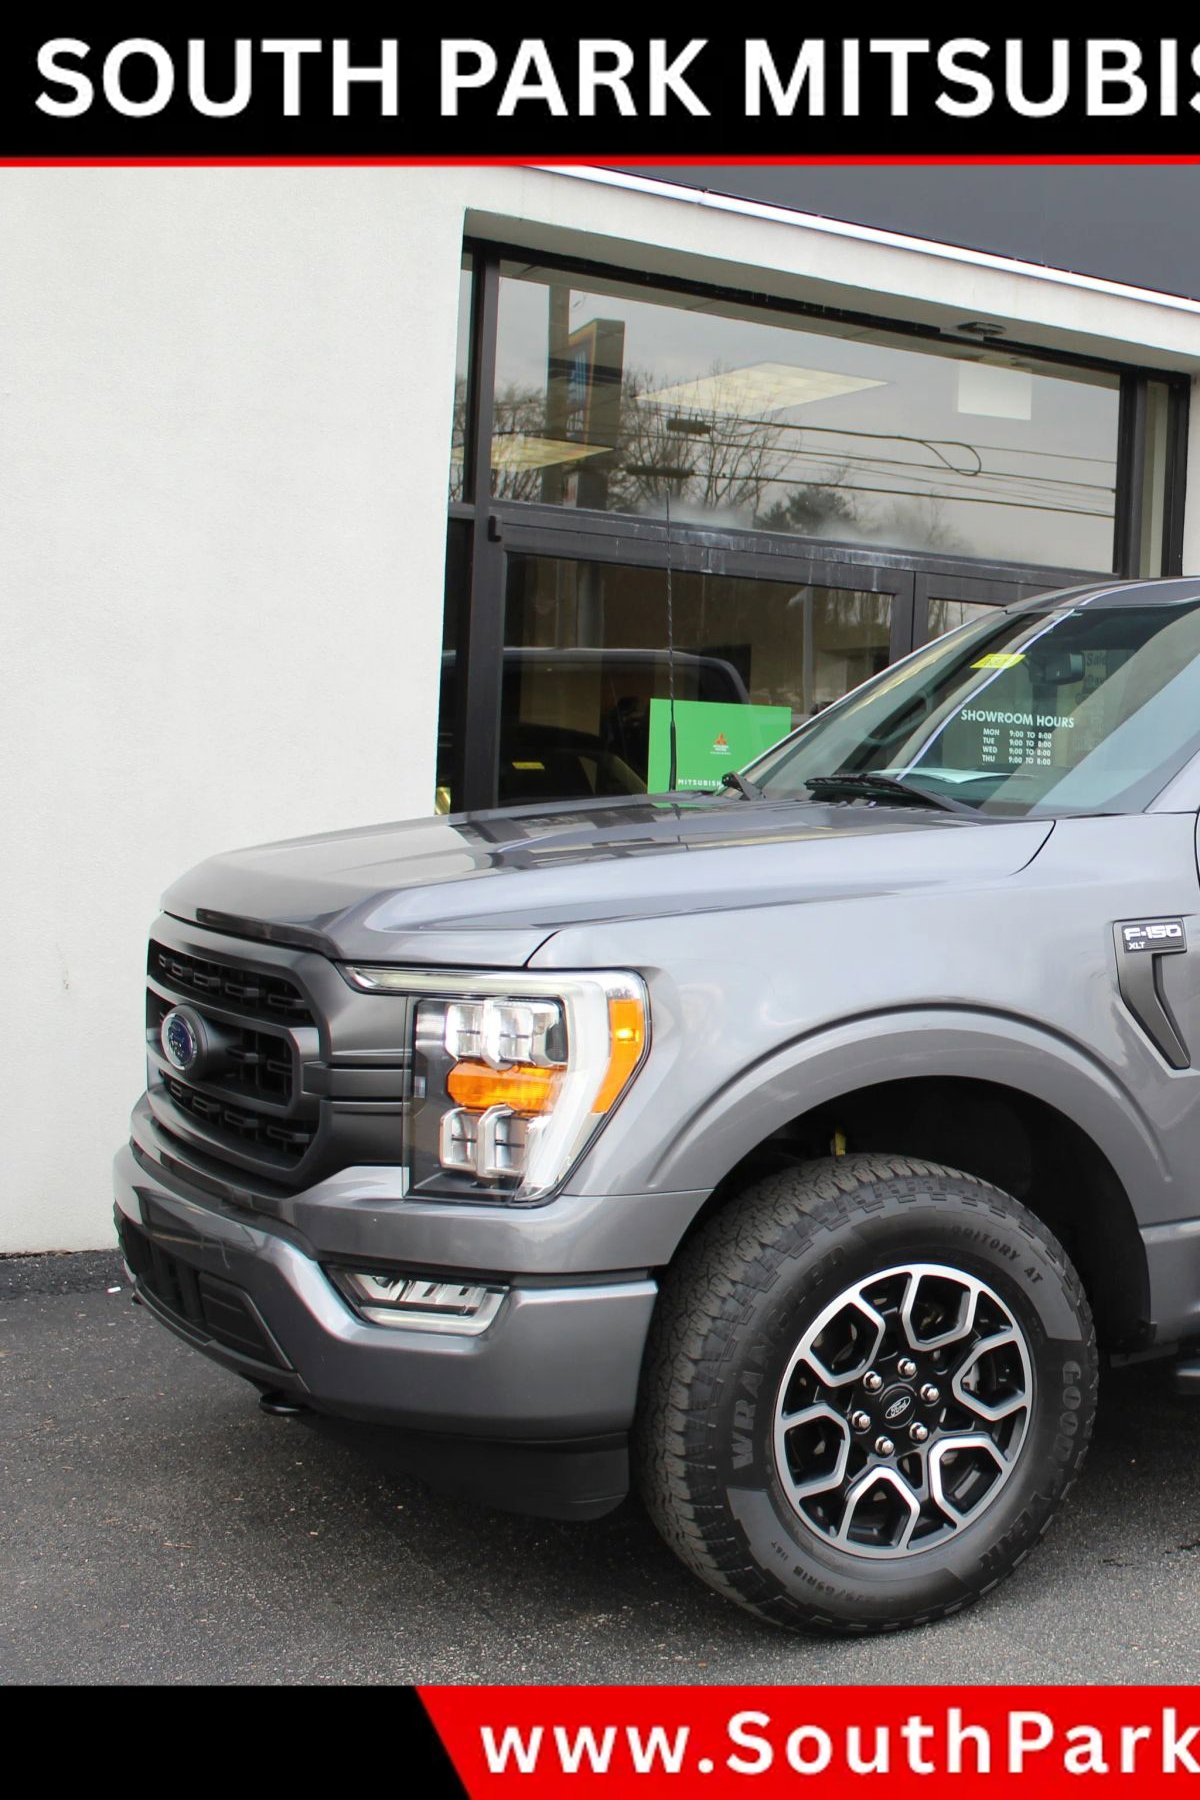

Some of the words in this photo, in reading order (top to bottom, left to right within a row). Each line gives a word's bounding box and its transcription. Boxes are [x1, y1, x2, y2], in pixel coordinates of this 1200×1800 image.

[961, 709, 1033, 726] SHOWROOM
[1036, 715, 1075, 728] HOURS
[983, 728, 1000, 736] MON
[1009, 730, 1024, 738] 9:00
[1009, 747, 1023, 755] 9:00
[1008, 756, 1022, 764] 9:00
[678, 779, 722, 787] MITSUBISH
[1124, 924, 1182, 940] F-150
[1129, 941, 1146, 950] XLT
[1024, 1266, 1043, 1283] AT
